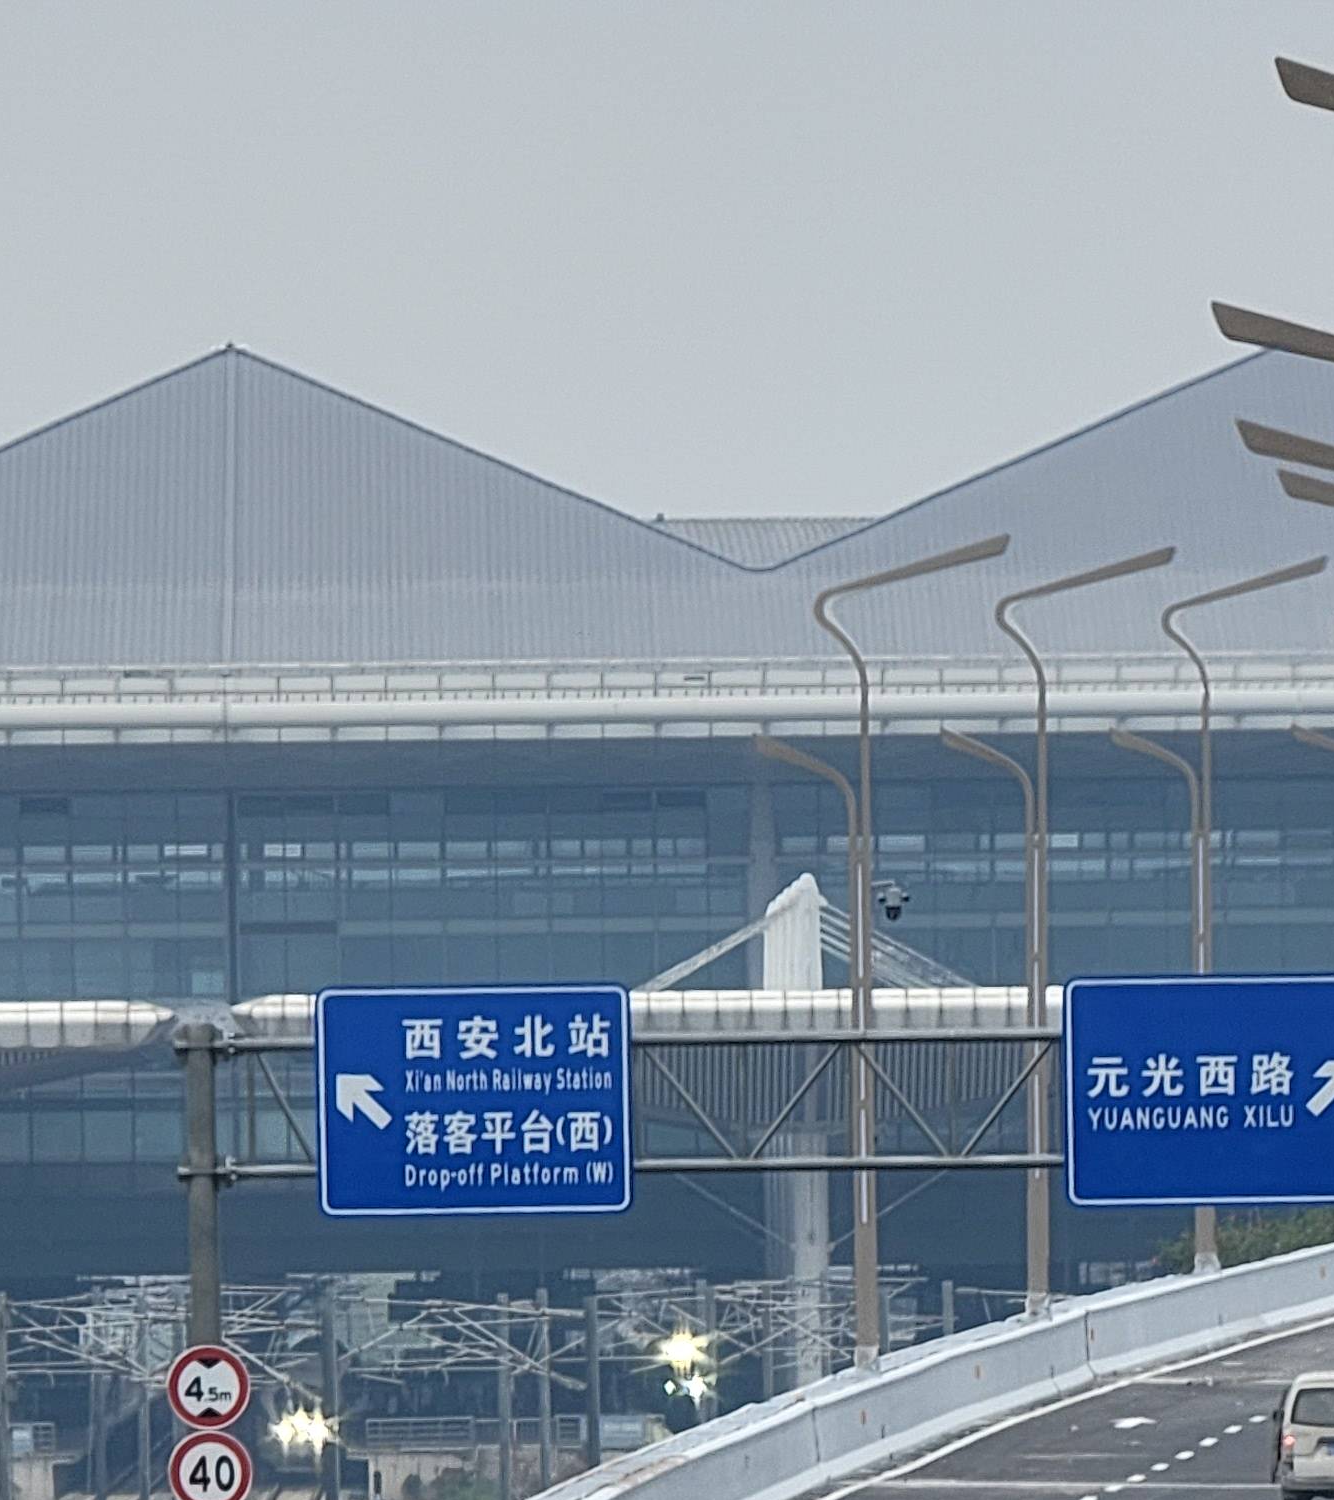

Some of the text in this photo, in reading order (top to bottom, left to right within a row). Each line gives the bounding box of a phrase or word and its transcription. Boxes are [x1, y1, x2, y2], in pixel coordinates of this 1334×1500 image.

[401, 1013, 611, 1060] 西安北站
[405, 1066, 613, 1095] Xi'an North Railway Station
[1086, 1051, 1294, 1098] 元光西路
[404, 1108, 613, 1155] 落客平台(西)
[1087, 1104, 1294, 1131] YUANGUANG XILU
[404, 1160, 614, 1192] Drop-off Platform (W)
[184, 1376, 232, 1402] 4.5m
[189, 1455, 235, 1492] 40
